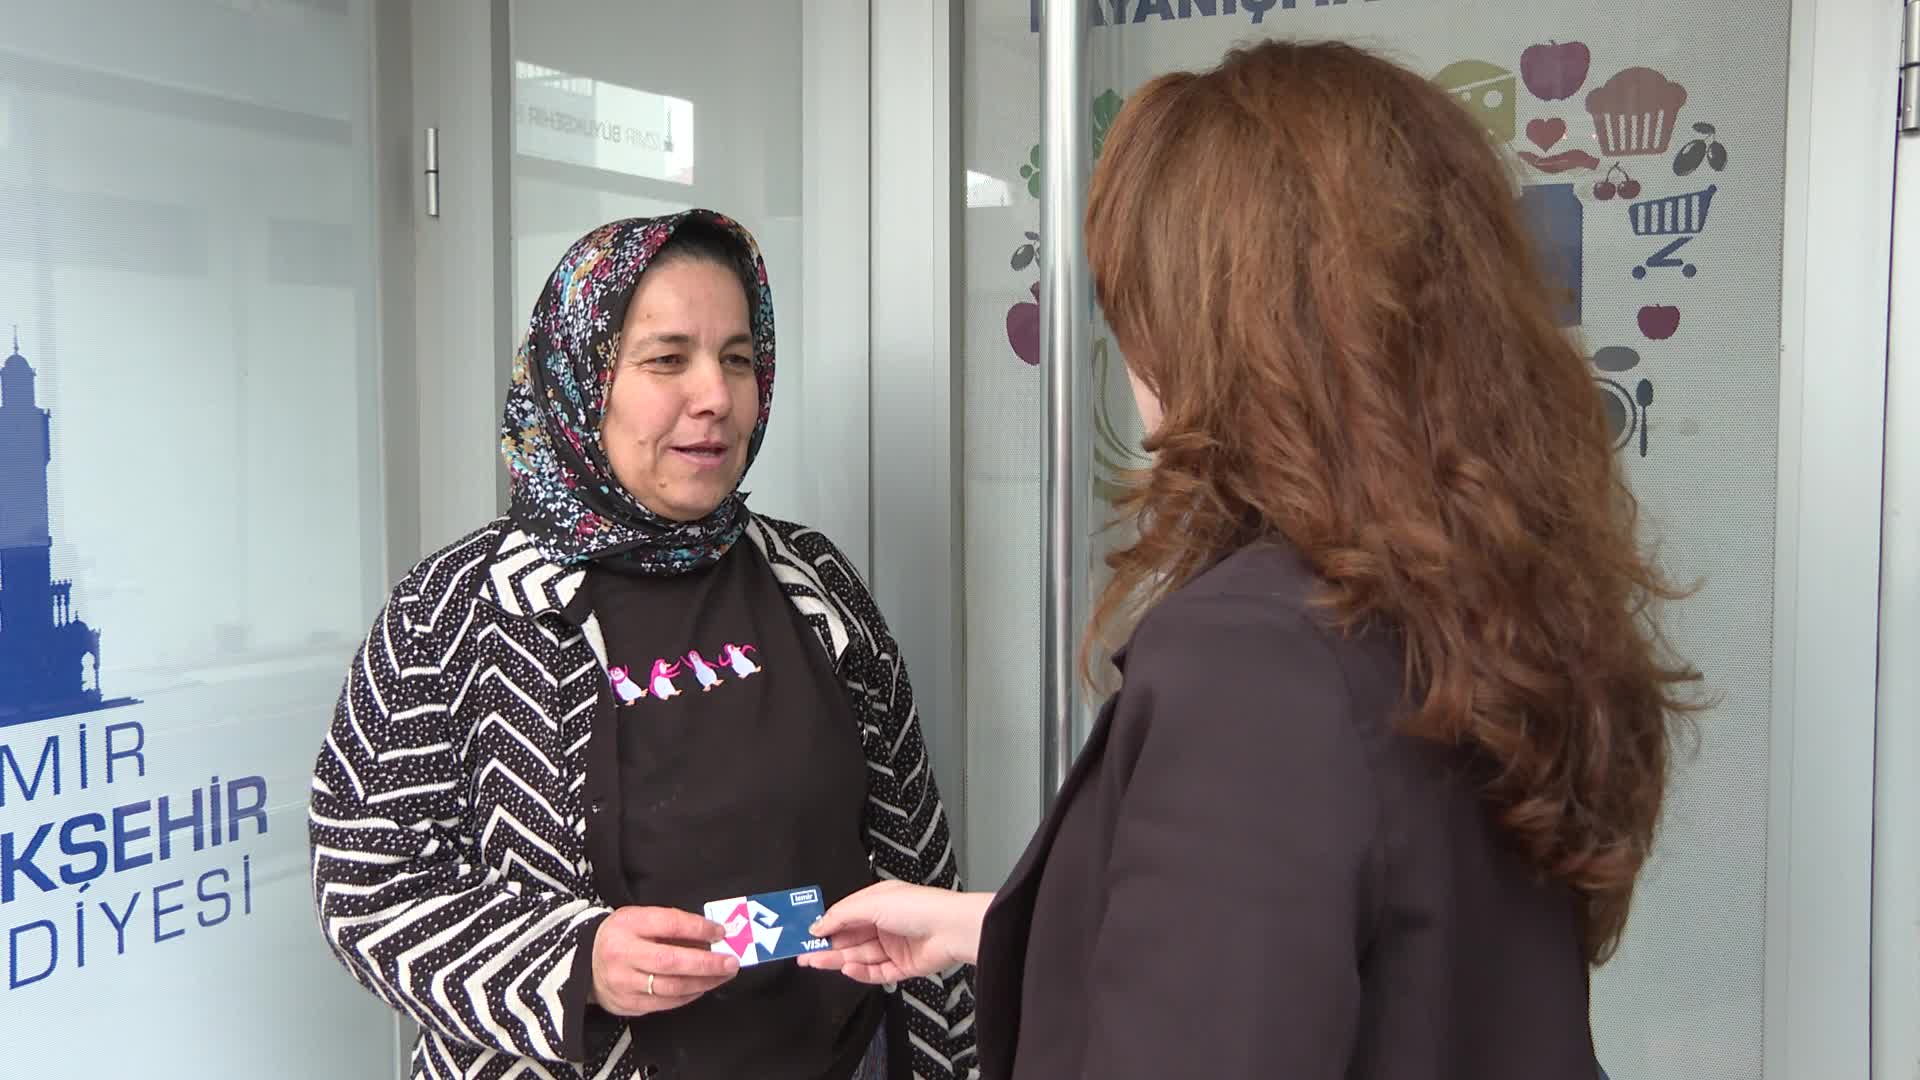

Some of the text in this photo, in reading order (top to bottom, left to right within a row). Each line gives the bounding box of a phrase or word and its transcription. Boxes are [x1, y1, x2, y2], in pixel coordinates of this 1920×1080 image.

[0, 721, 145, 807] MİR
[0, 775, 267, 903] KŞEHİR
[9, 854, 251, 990] DİYESİ
[800, 937, 829, 951] VISA
